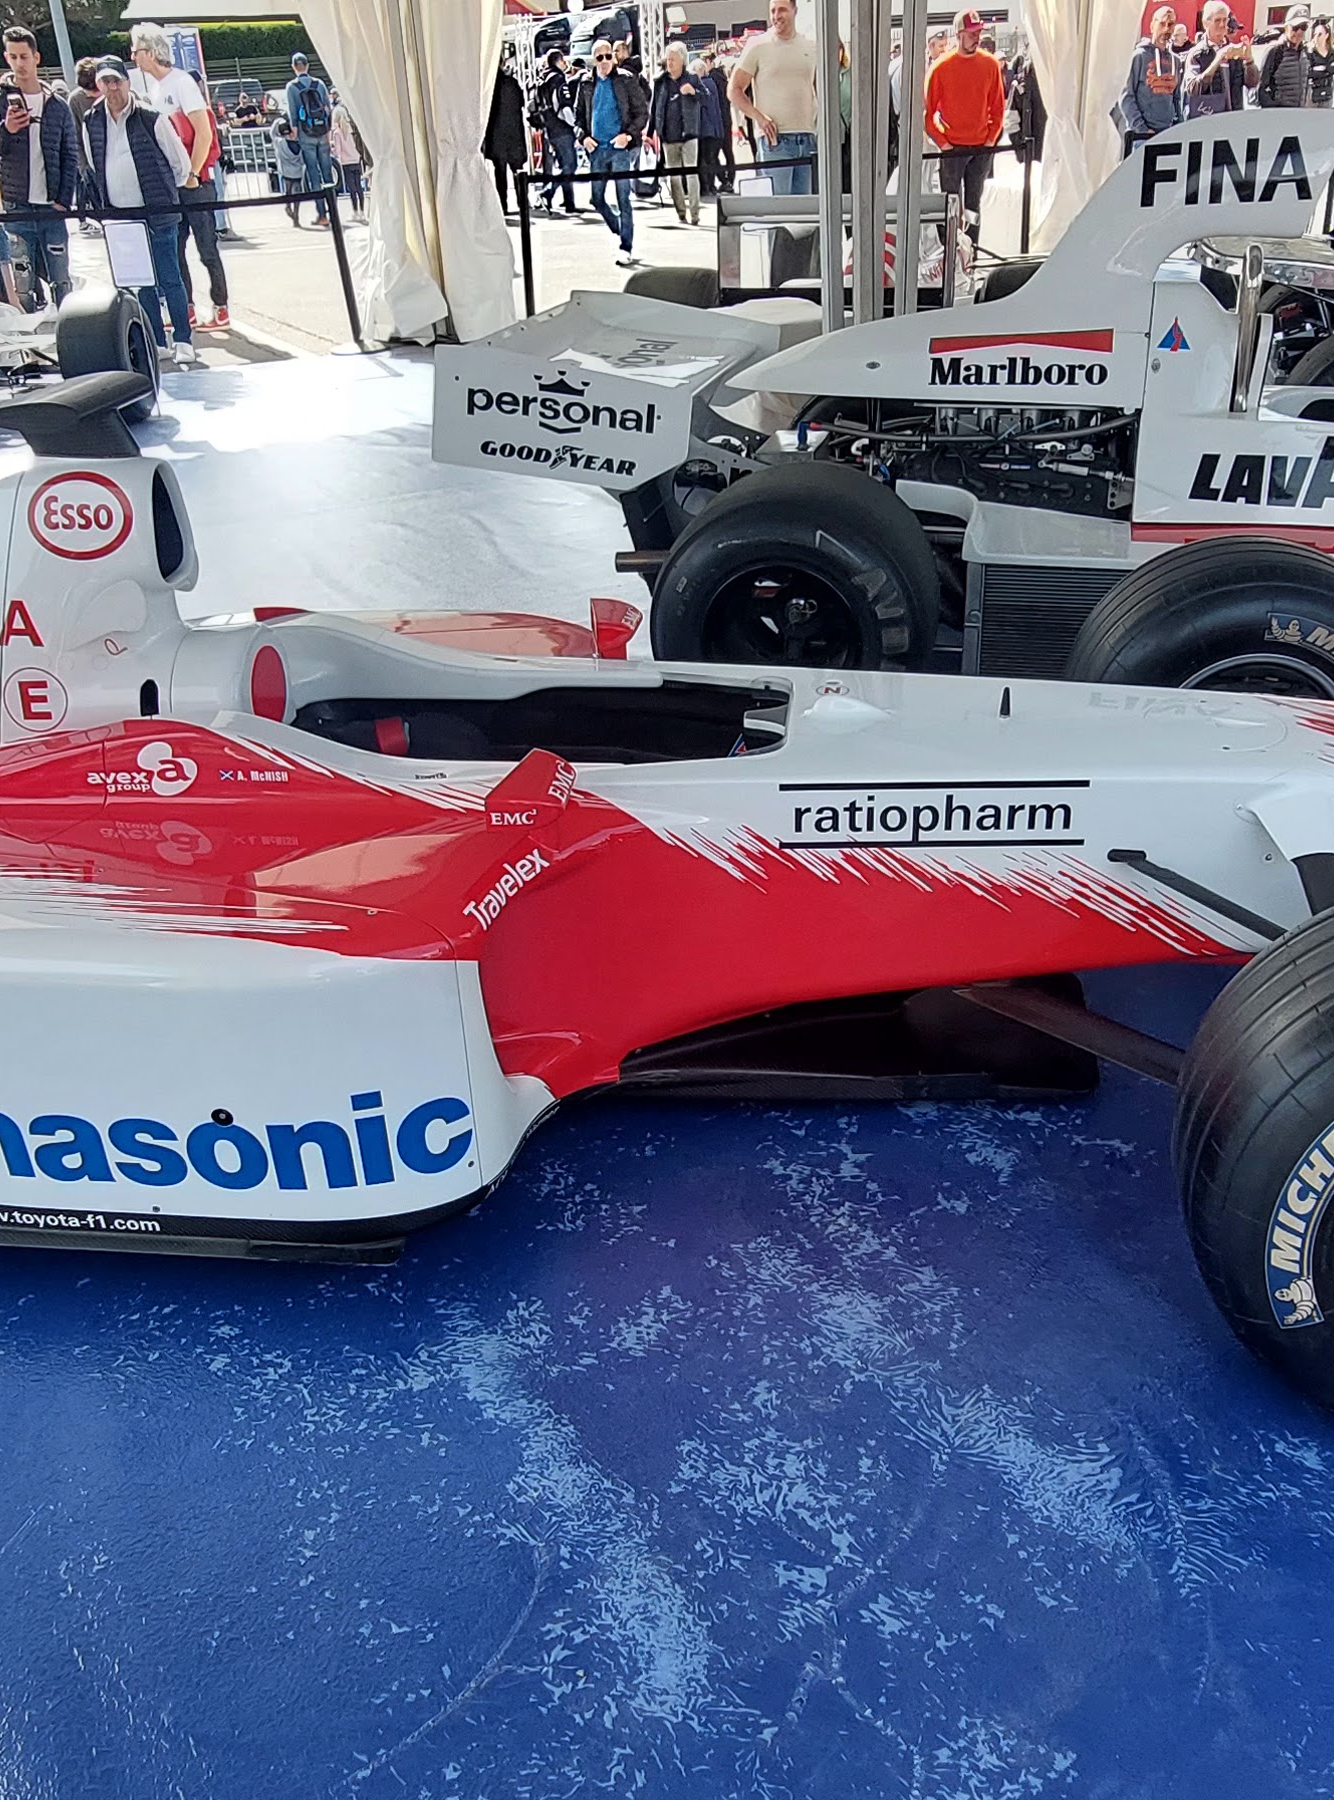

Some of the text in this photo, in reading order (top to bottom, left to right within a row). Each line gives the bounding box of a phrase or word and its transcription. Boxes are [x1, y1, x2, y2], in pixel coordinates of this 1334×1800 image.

[1138, 136, 1317, 209] FINA
[928, 356, 1108, 387] Marlboro
[467, 387, 656, 434] personal
[17, 680, 53, 721] E
[86, 770, 150, 786] avex
[106, 783, 151, 793] group
[793, 794, 1073, 844] ratiopharm
[462, 848, 551, 931] Travelex
